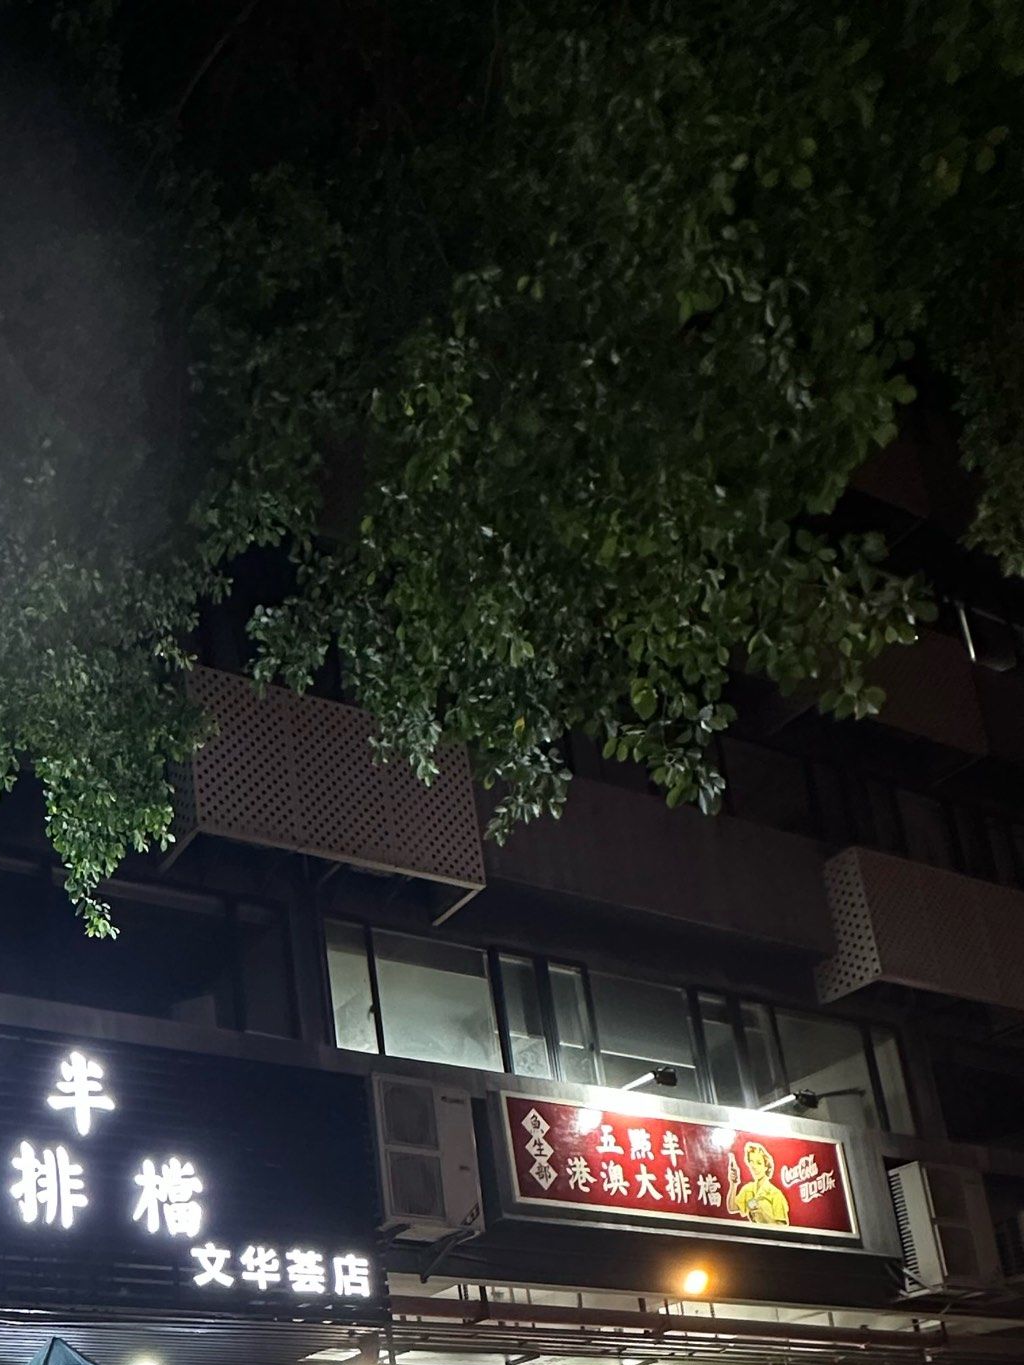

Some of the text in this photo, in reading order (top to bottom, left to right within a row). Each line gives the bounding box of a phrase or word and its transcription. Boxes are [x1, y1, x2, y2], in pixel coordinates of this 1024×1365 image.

[566, 1155, 723, 1208] 港澳大排檔
[191, 1242, 372, 1298] 文华荟店
